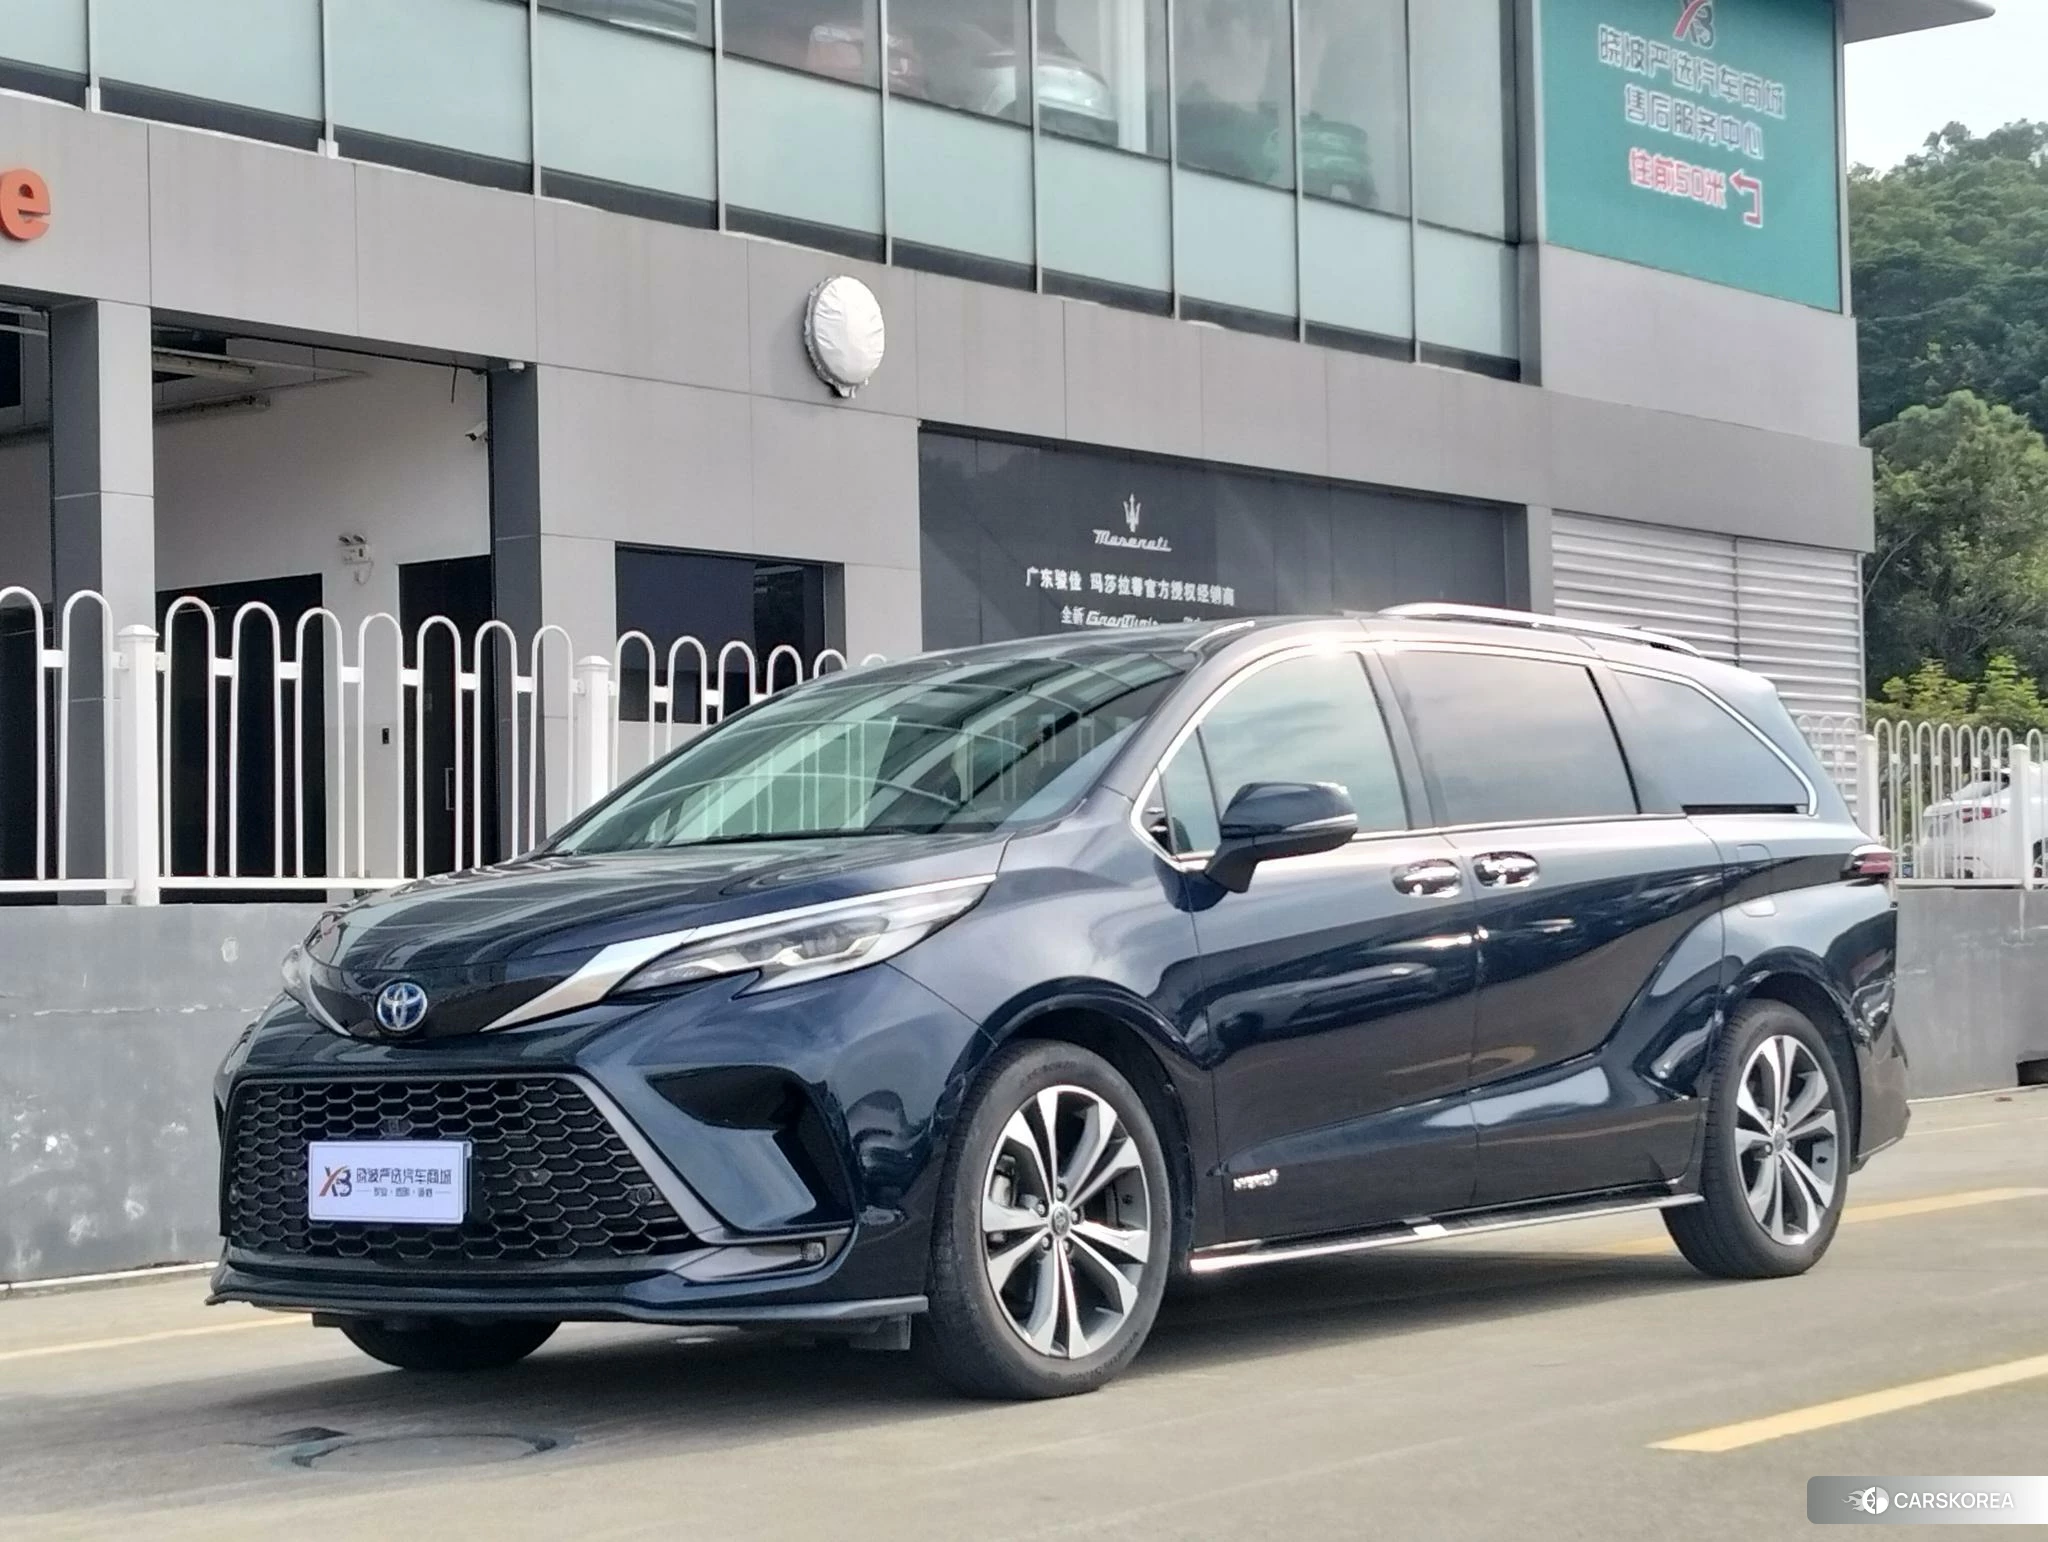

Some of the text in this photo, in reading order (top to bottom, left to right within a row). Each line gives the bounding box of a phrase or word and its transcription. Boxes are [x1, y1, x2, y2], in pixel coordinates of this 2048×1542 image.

[1624, 83, 1764, 160] 售后服务中心
[1629, 147, 1728, 209] 往前50米
[1092, 529, 1172, 552] Maserati
